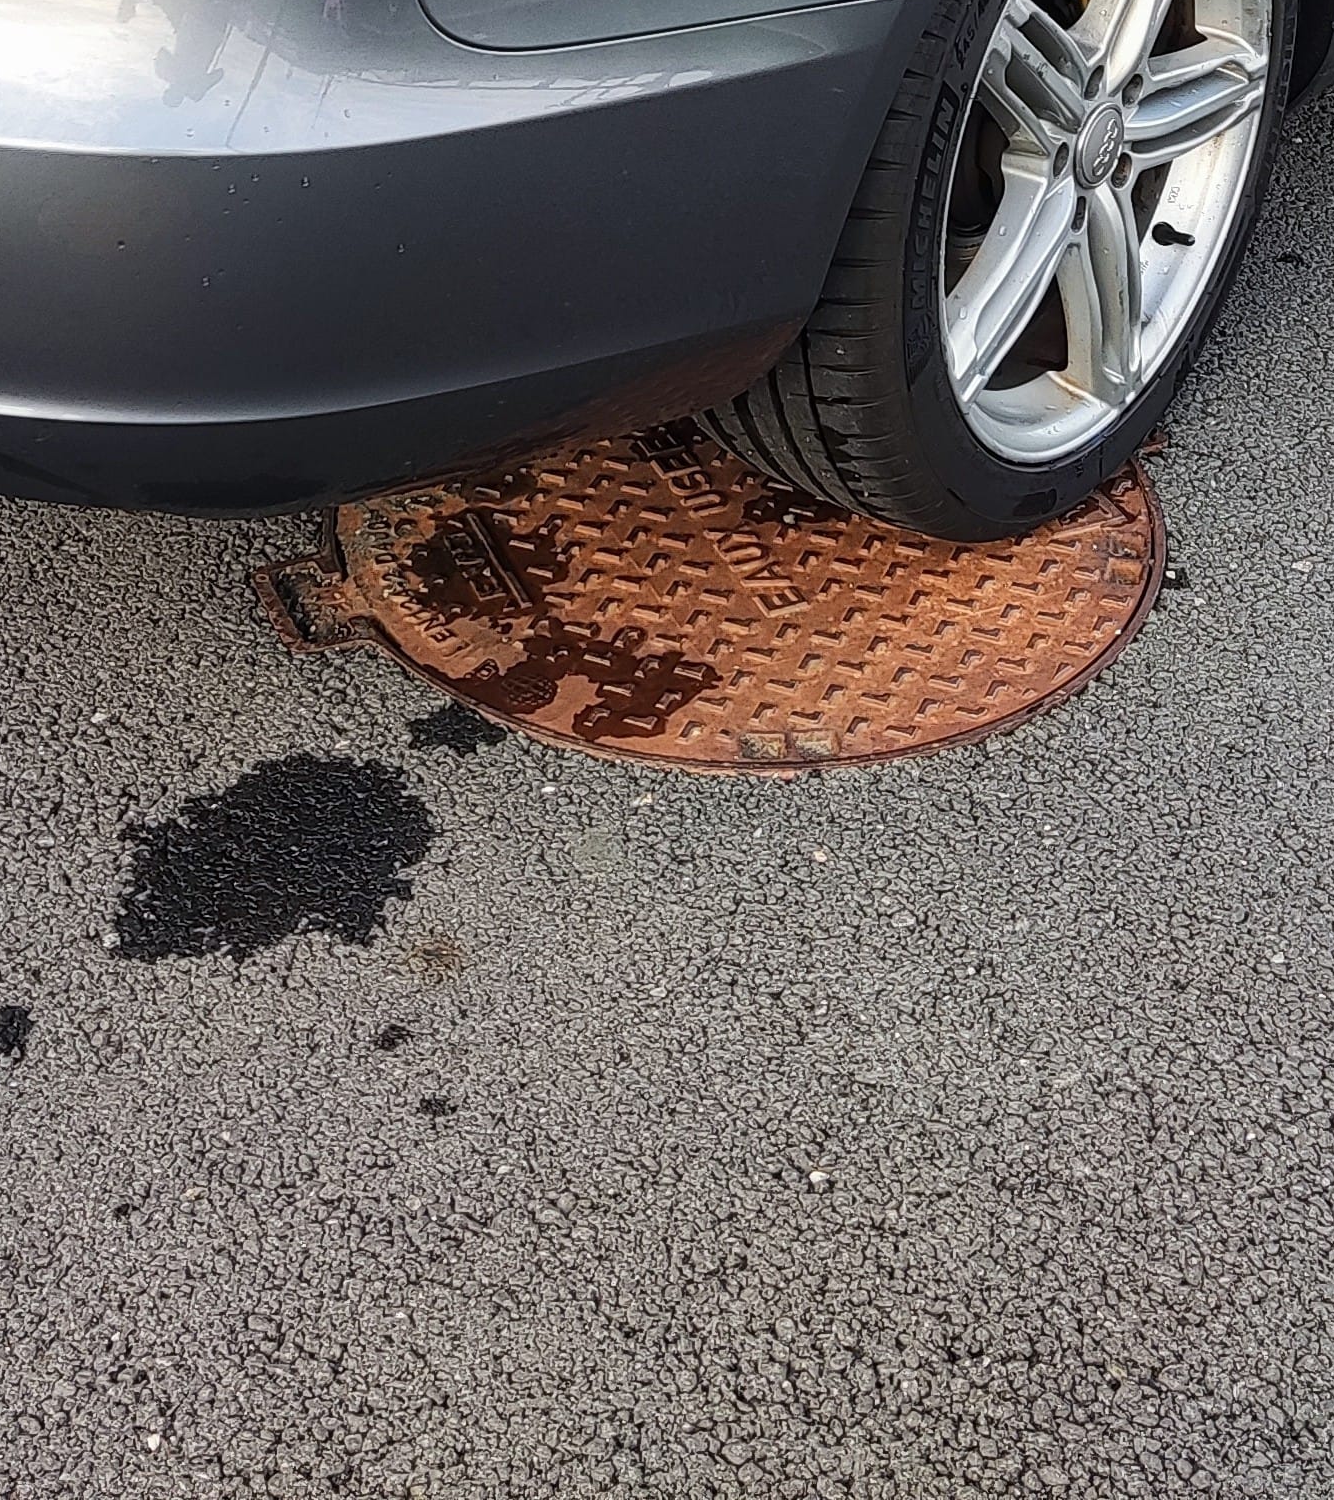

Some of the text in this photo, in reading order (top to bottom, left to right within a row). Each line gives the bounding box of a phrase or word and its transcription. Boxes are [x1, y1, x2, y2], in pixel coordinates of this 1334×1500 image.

[910, 97, 956, 311] MICHELIN
[637, 433, 728, 518] USEE
[703, 528, 811, 618] EAUX
